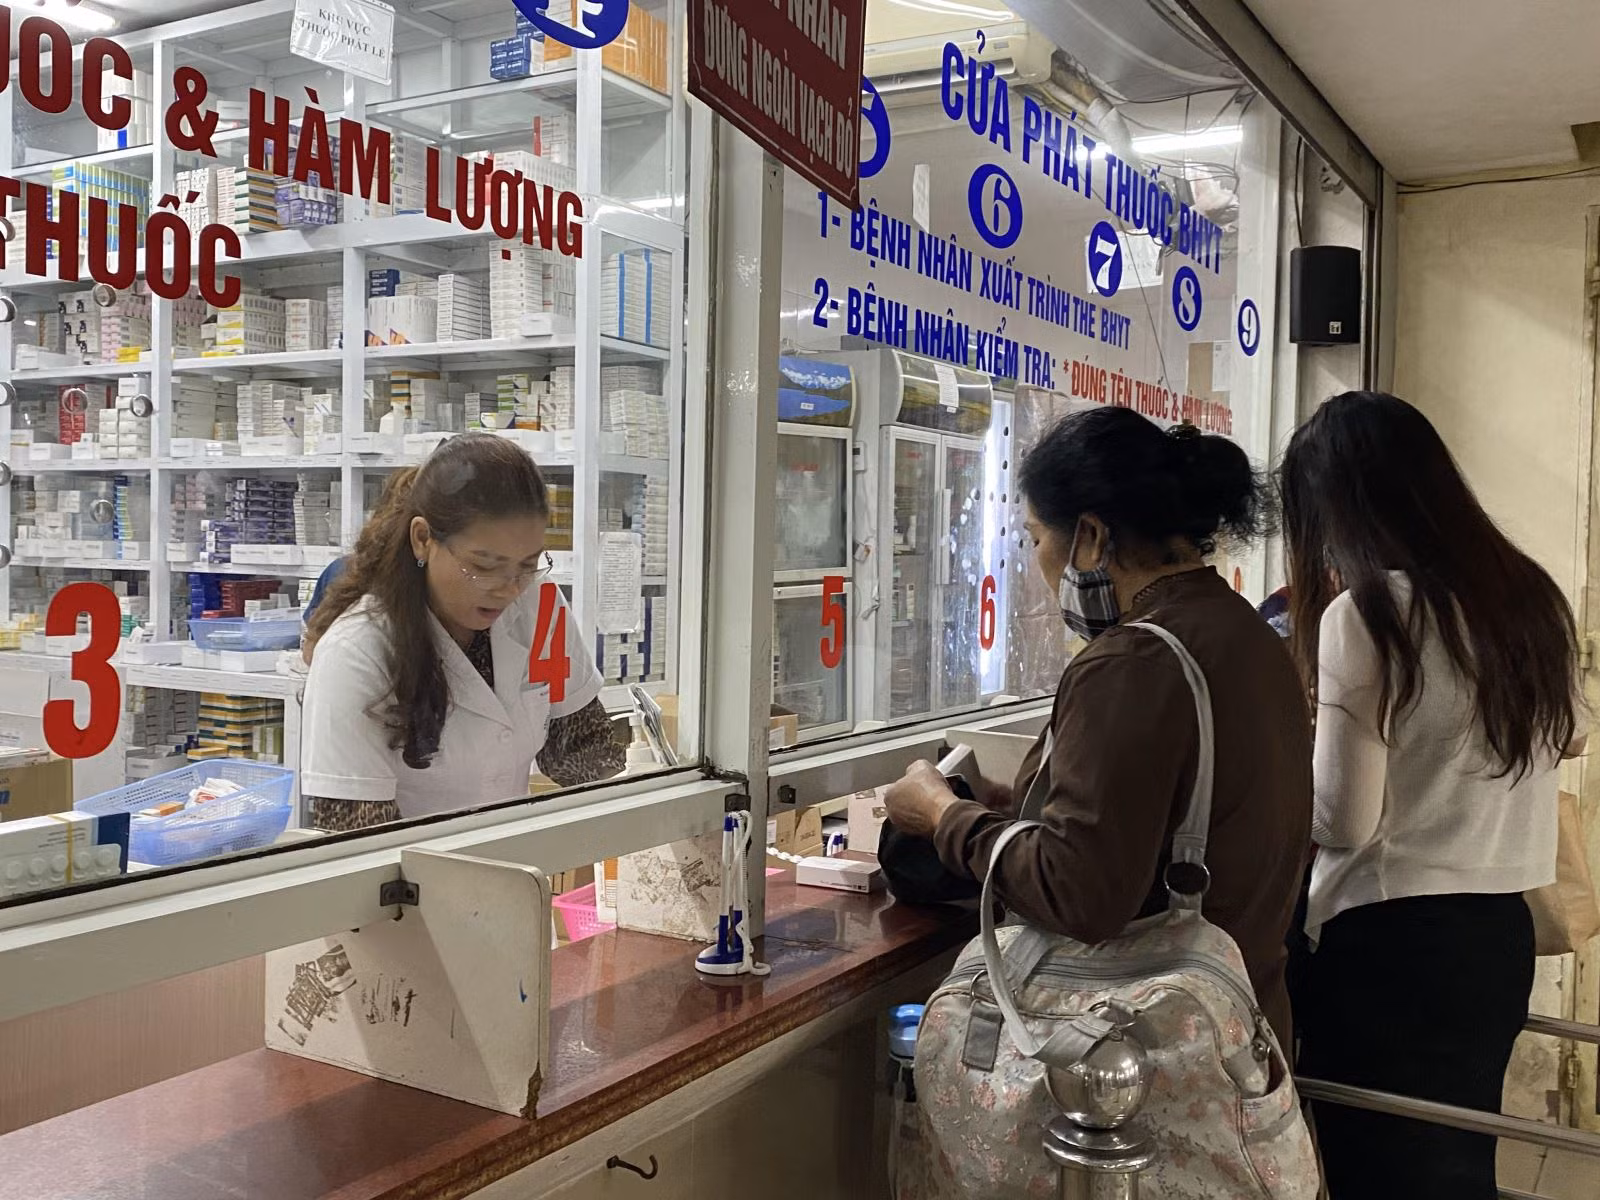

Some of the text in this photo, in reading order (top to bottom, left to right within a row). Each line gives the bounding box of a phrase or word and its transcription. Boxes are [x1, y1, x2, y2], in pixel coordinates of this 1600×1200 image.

[166, 67, 217, 158] &
[248, 86, 391, 205] HÀM
[426, 147, 584, 260] LƯỢNG
[752, 37, 796, 137] NGOÀI
[799, 80, 834, 165] VẠCH
[836, 97, 854, 179] ĐỎ
[941, 30, 1224, 275] CỬA PHÁT THUỐC BHYT
[846, 281, 909, 351] BỆNH
[914, 307, 970, 366] NHÂN
[975, 316, 1020, 381] KIỂM
[1023, 344, 1057, 390] TRA:
[850, 197, 911, 269] BỆNH
[917, 230, 973, 293] NHÂN
[979, 255, 1024, 312] XUẤT
[1027, 274, 1071, 329] TRÌNH
[1100, 307, 1132, 350] BHYT
[1110, 367, 1133, 408] TÊN
[1135, 376, 1169, 420] THUỐC
[1171, 391, 1178, 422] &
[43, 581, 121, 759] 3
[528, 582, 571, 704] 4
[819, 575, 846, 669] 5
[979, 574, 996, 651] 6
